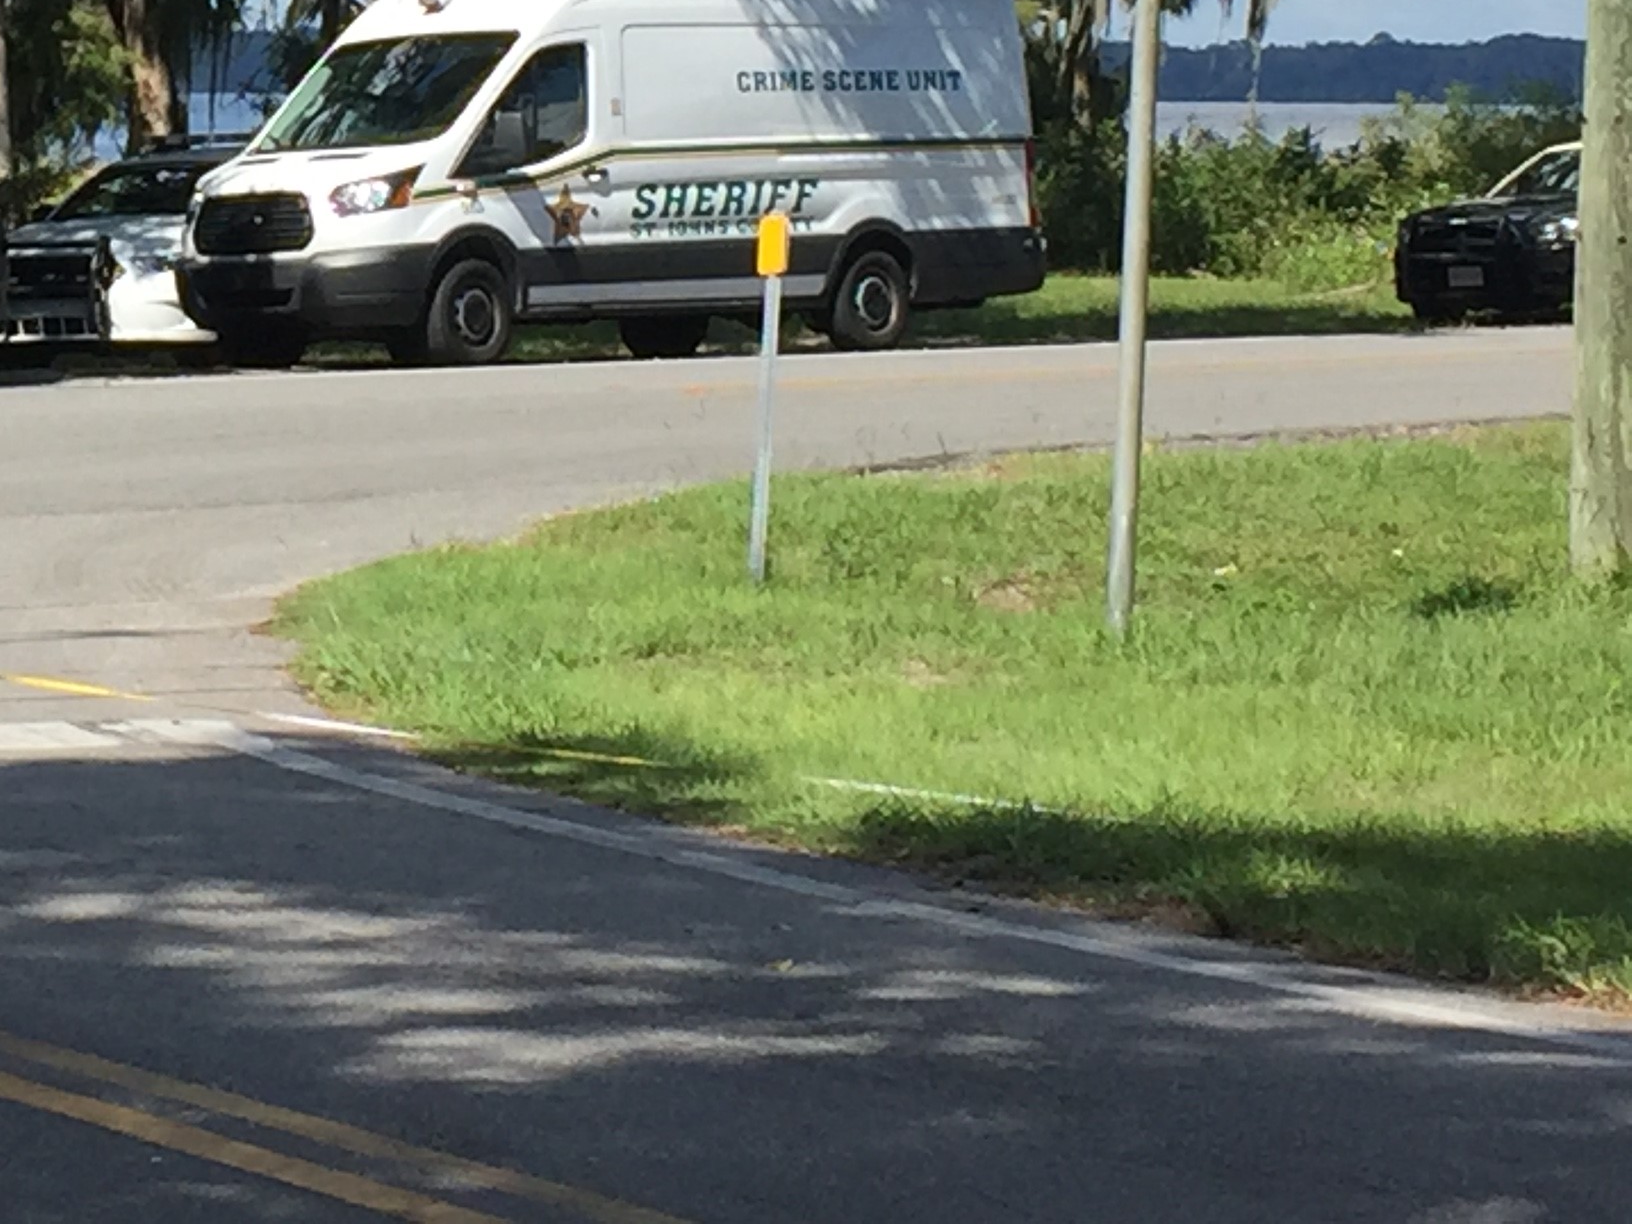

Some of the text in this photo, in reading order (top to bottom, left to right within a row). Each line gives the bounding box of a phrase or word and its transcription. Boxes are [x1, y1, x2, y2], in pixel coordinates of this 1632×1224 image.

[736, 69, 962, 93] CRIME SCENE UNIT
[631, 178, 818, 219] SHERIFF
